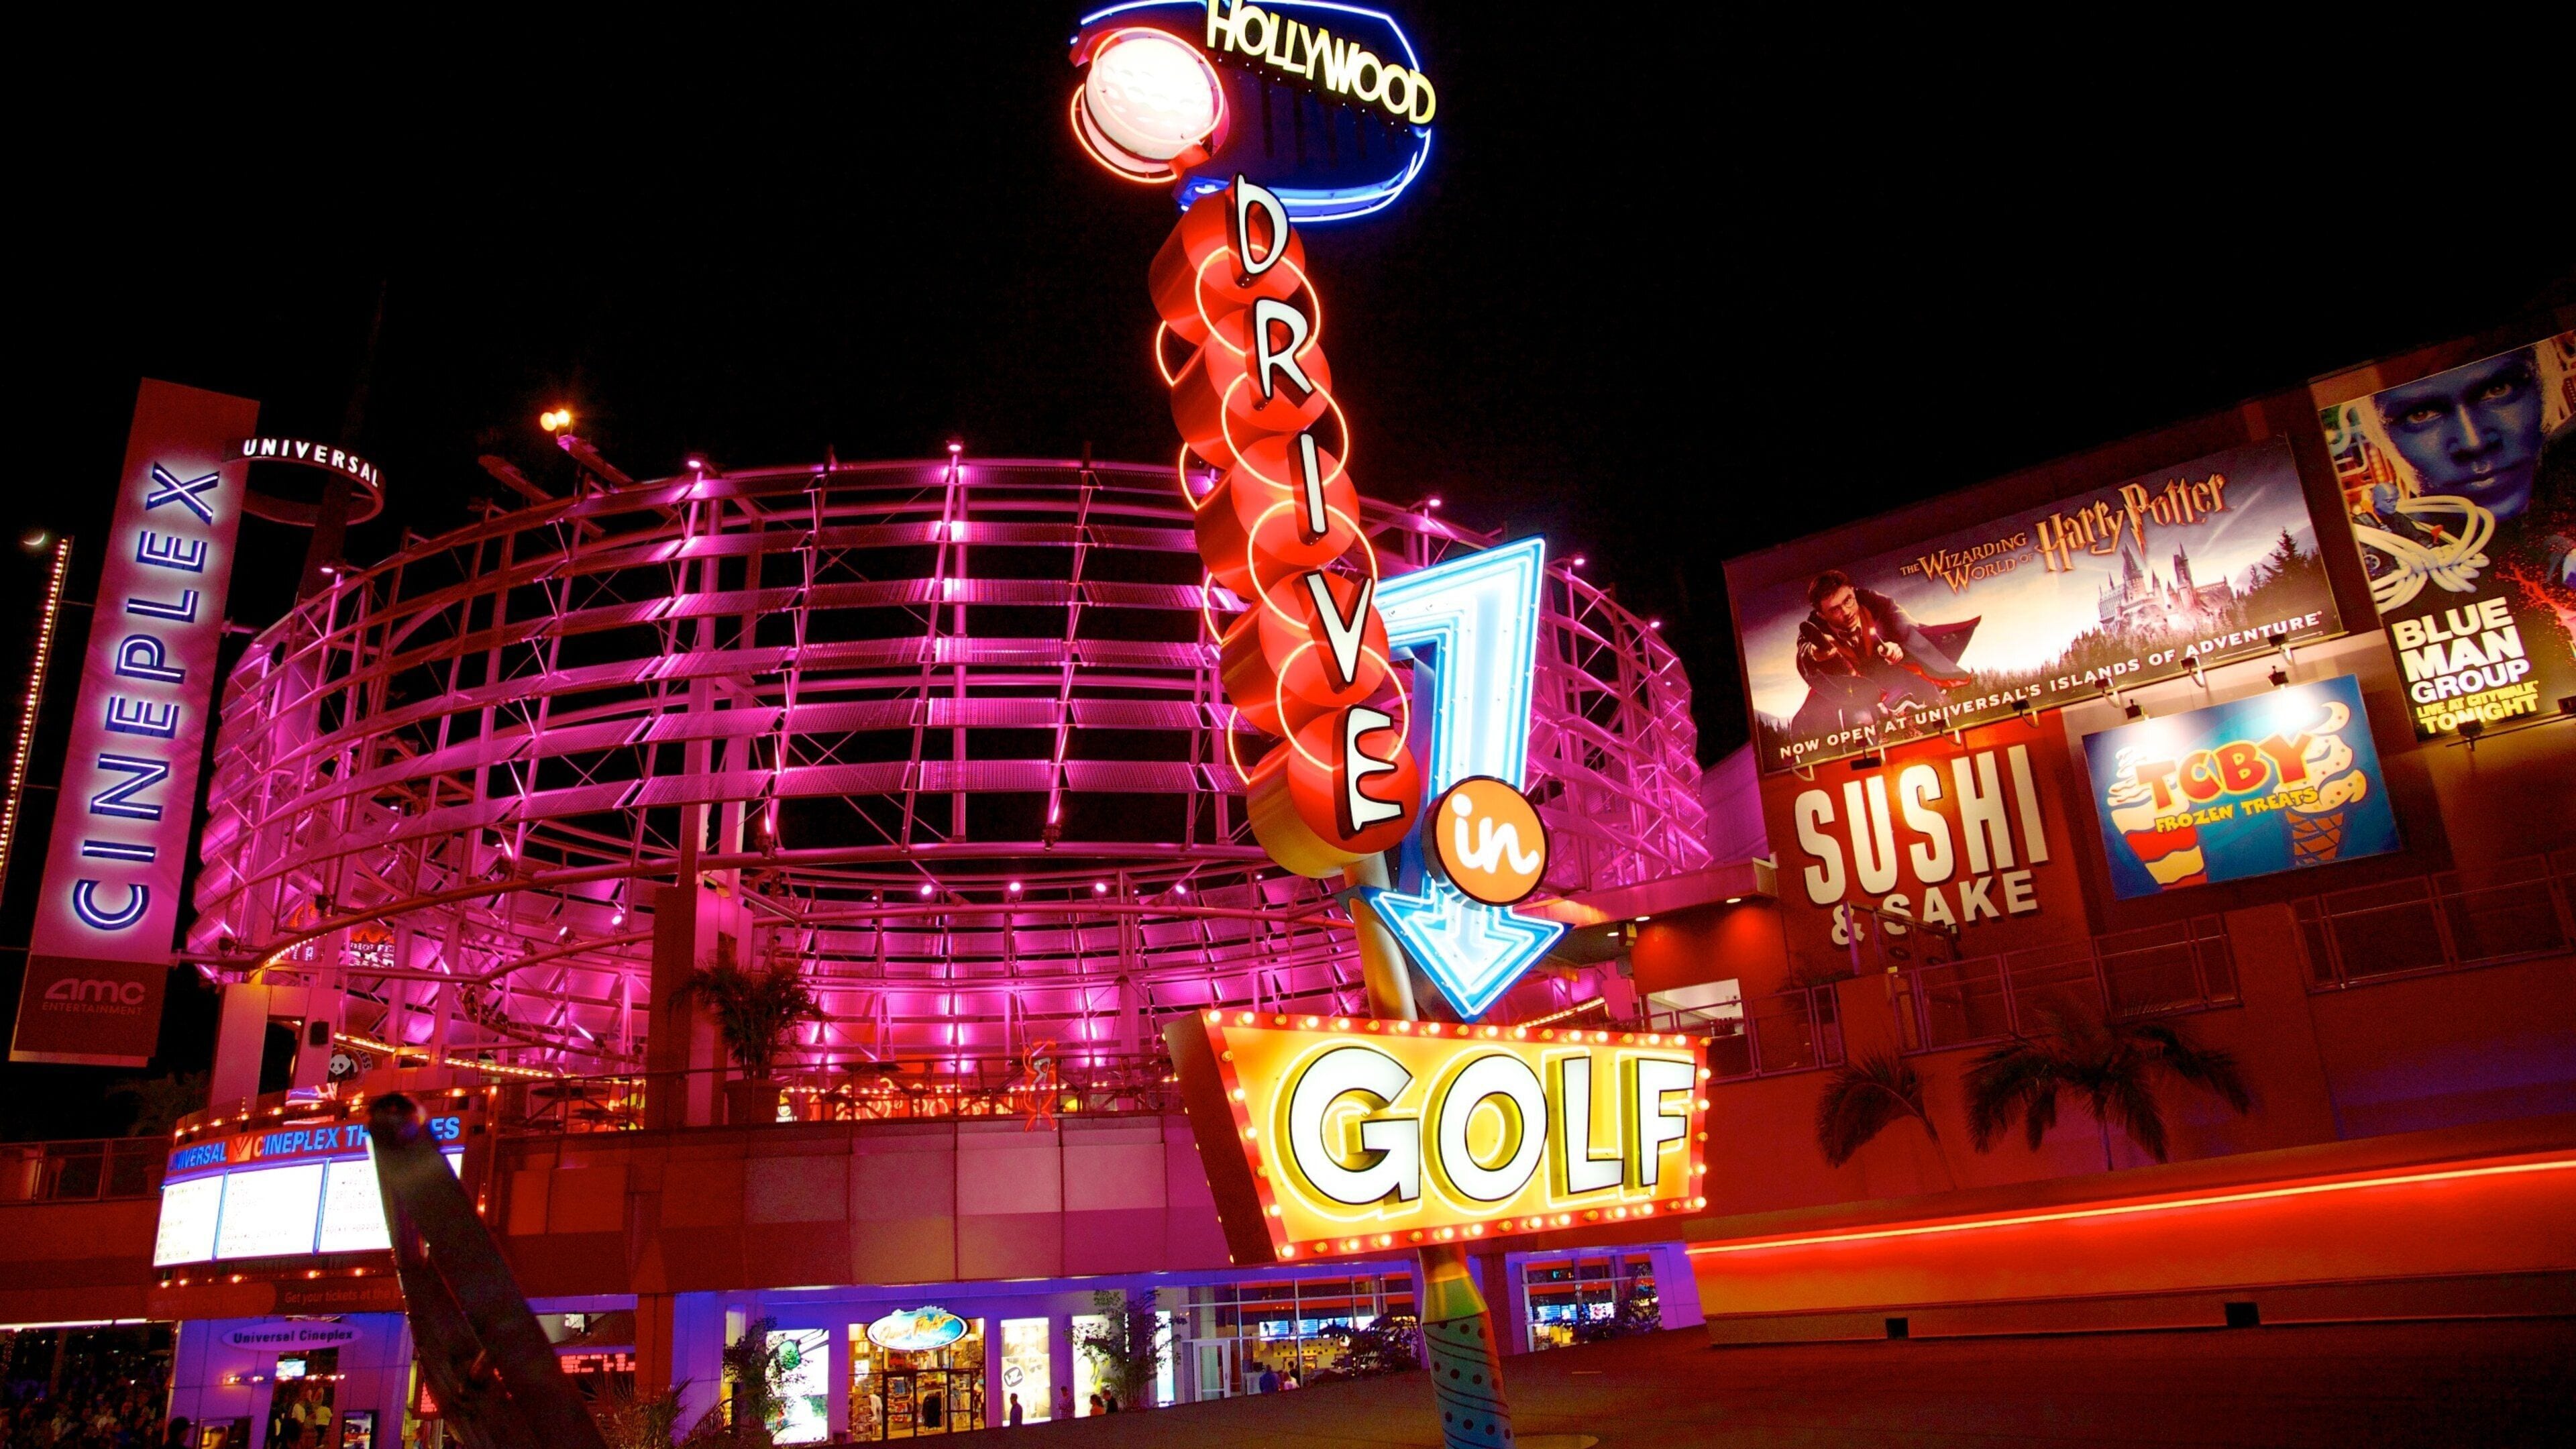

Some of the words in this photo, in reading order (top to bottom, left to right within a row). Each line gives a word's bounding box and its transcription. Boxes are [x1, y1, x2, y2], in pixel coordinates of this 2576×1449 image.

[1207, 0, 1436, 125] HOLLYWOOD
[243, 438, 378, 487] UNIVERSAL
[1234, 172, 1405, 834] DRIVE
[2034, 500, 2124, 572] Harry
[2118, 473, 2228, 559] Potter
[1900, 562, 1920, 576] THE
[1943, 562, 2016, 595] WORLD
[2019, 553, 2033, 563] OF
[2392, 596, 2514, 651] BLUE
[2400, 625, 2525, 683] MAN
[2410, 658, 2530, 704] GROUP
[72, 461, 220, 930] CINEPLEX
[1780, 738, 1819, 759] NOW
[1827, 724, 1876, 746] OPEN
[1884, 716, 1907, 733] AT
[1915, 683, 2041, 724] UNIVERSAL'S
[2050, 658, 2141, 692] ISLANDS
[2148, 648, 2176, 666] OF
[2416, 701, 2447, 718] LIVE
[2449, 697, 2465, 711] AT
[2419, 692, 2539, 735] TONIGHT
[2135, 731, 2317, 813] TCBY
[1451, 793, 1540, 874] in
[1794, 744, 2049, 905] SUSHI
[2154, 803, 2235, 834] FROZEN
[2241, 786, 2319, 818] TREATS
[1831, 904, 1866, 946] &
[1882, 869, 2038, 936] SAKE
[42, 1002, 144, 1016] ENTERTAINMENT
[168, 1141, 227, 1171] UNIVERSAL
[254, 1127, 341, 1157] CINEPLEX
[1289, 1046, 1697, 1205] GOLF
[285, 1292, 301, 1303] Get
[325, 1289, 358, 1301] tickets
[234, 1330, 294, 1344] Universal
[299, 1329, 353, 1342] Cineplex
